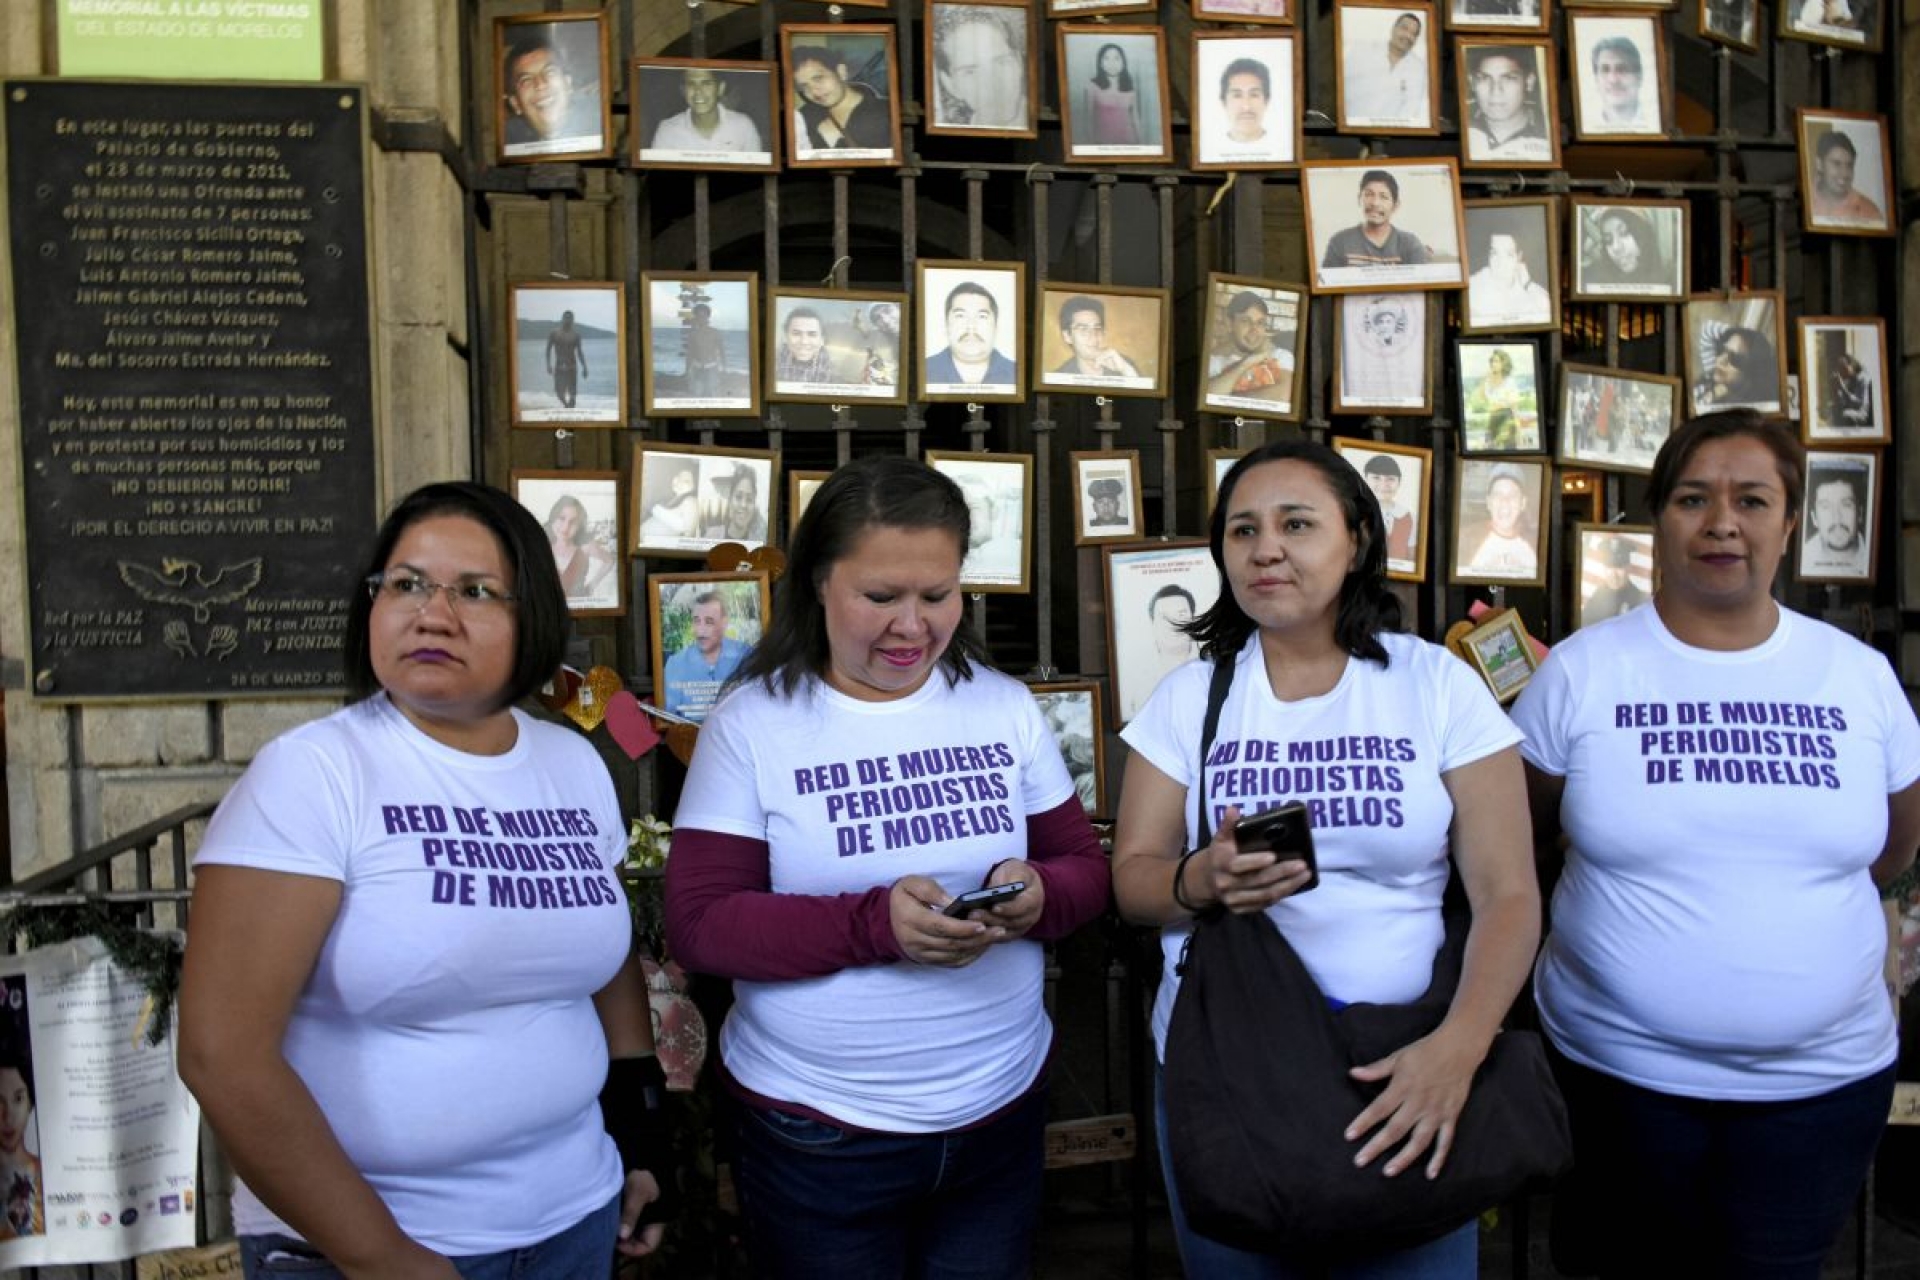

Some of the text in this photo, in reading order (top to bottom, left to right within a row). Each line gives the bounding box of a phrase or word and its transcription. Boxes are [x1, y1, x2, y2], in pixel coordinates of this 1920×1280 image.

[168, 1, 179, 16] A
[186, 1, 219, 17] LAS
[77, 21, 304, 38] DEL ESTADO DE MORELOS
[48, 420, 75, 434] por
[79, 416, 124, 431] haber
[130, 416, 186, 431] abierto
[191, 416, 213, 431] los
[217, 417, 250, 433] ojos
[255, 415, 274, 430] de
[279, 415, 293, 430] la
[52, 436, 345, 457] y en protesta por sus homicidios y los
[71, 460, 90, 474] de
[96, 459, 152, 473] muchas
[157, 461, 227, 477] personas
[269, 460, 321, 475] porque
[147, 480, 224, 493] DEBIERON
[114, 520, 133, 535] EL
[138, 519, 212, 535] DERECHO
[215, 519, 227, 534] A
[230, 518, 270, 533] VIVIR
[275, 518, 294, 533] EN
[1616, 702, 1848, 731] RED DE MUJERES
[1244, 739, 1279, 763] DE
[1287, 735, 1417, 763] MUJERES
[1641, 728, 1838, 760] PERIODISTAS
[794, 741, 1015, 795] RED DE MUJERES
[1211, 765, 1405, 799] PERIODISTAS
[1647, 758, 1841, 789] DE MORELOS
[825, 772, 1010, 823] PERIODISTAS
[382, 805, 598, 839] RED DE MUJERES
[836, 804, 1015, 858] DE MORELOS
[422, 838, 604, 871] PERIODISTAS
[432, 870, 617, 909] DE MORELOS
